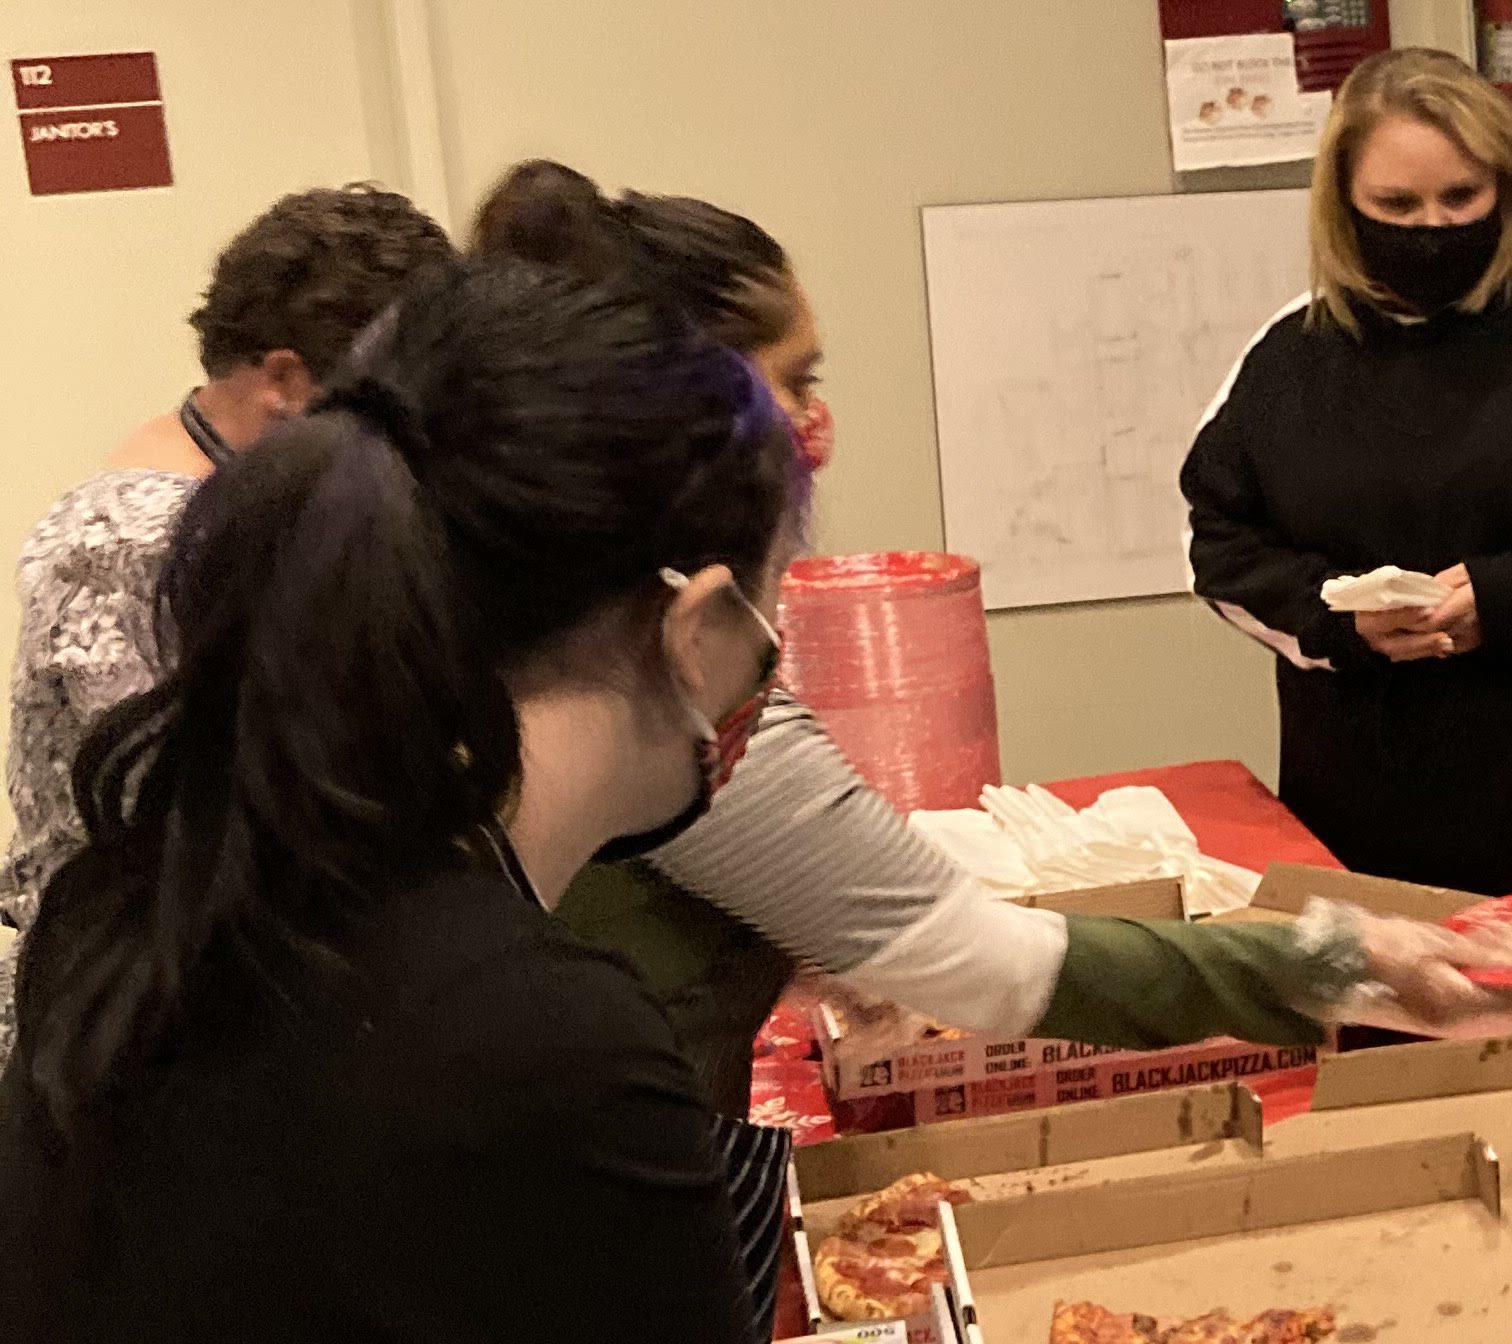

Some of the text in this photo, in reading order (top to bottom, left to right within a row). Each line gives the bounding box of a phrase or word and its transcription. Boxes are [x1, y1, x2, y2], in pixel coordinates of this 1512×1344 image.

[986, 1041, 1025, 1057] ORDER
[1056, 1068, 1096, 1084] ORDER
[1111, 1046, 1317, 1094] BLACKJACKPIZZA.COM
